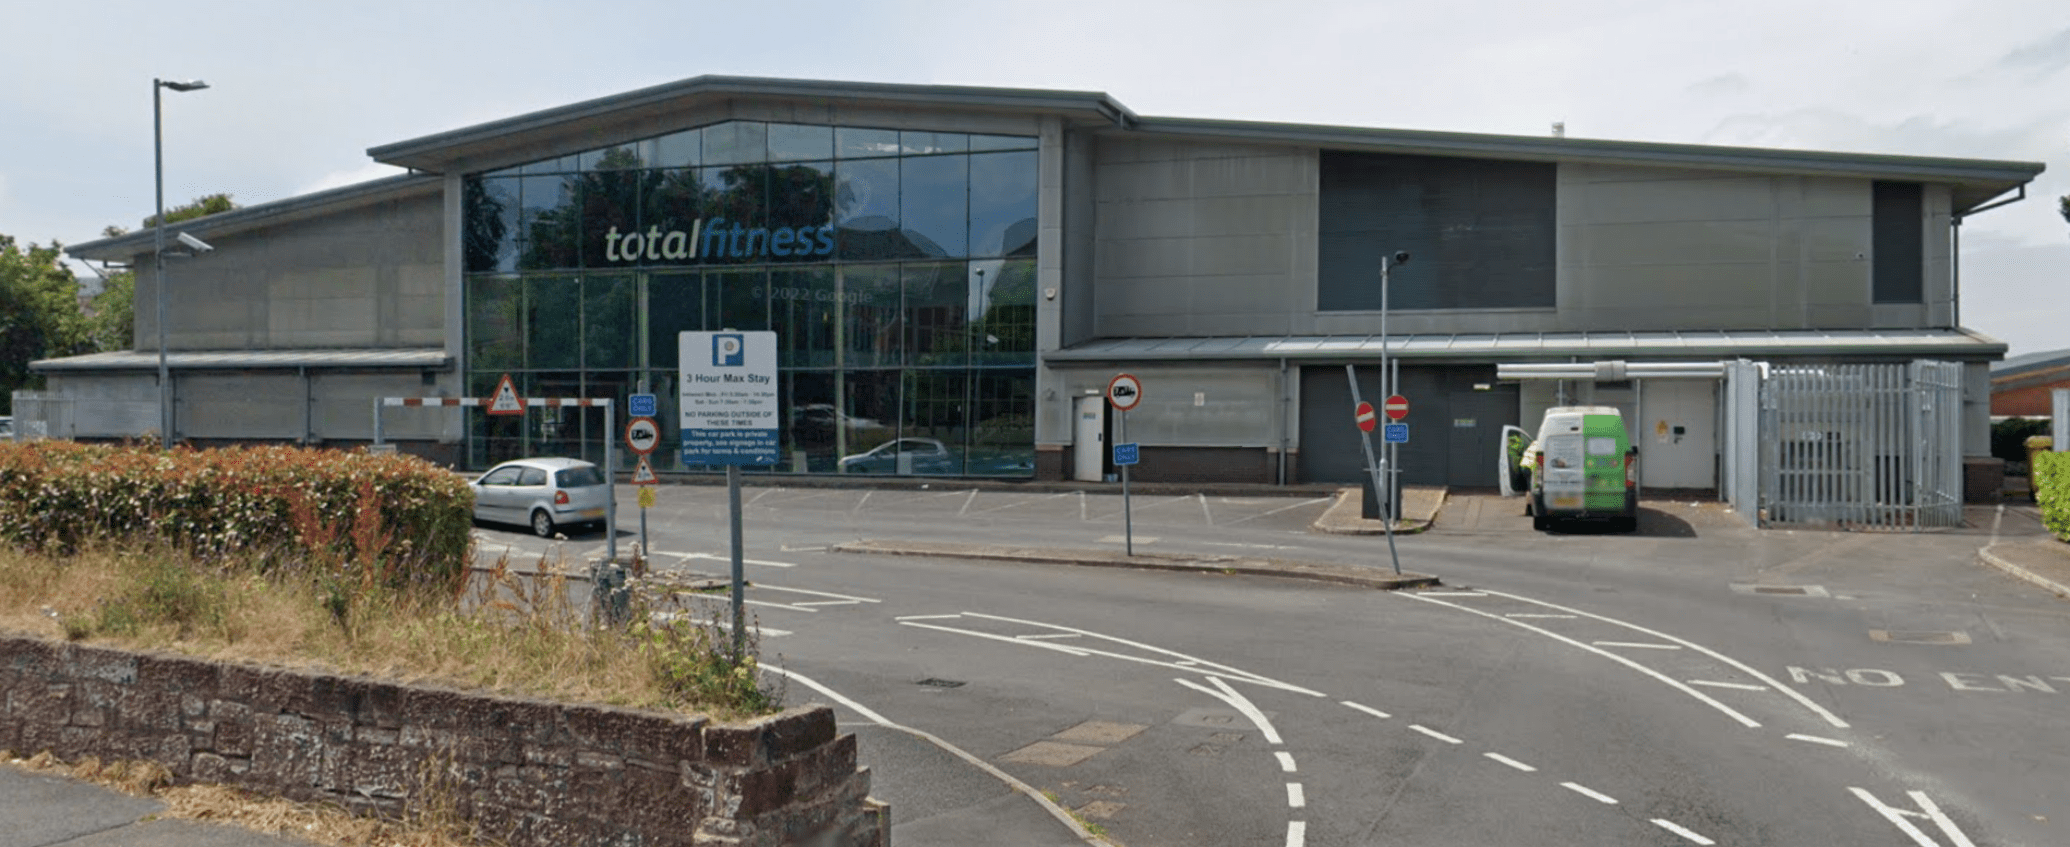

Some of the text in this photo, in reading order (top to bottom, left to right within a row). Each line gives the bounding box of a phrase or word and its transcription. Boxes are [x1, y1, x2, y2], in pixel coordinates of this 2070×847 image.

[687, 373, 770, 385] 3 Hour Max Stay
[691, 430, 706, 438] This
[720, 430, 735, 439] park
[744, 430, 768, 439] private
[729, 439, 756, 448] signage
[683, 448, 699, 456] park
[733, 447, 739, 455] &
[740, 447, 776, 455] conditions
[1785, 665, 1905, 687] NO
